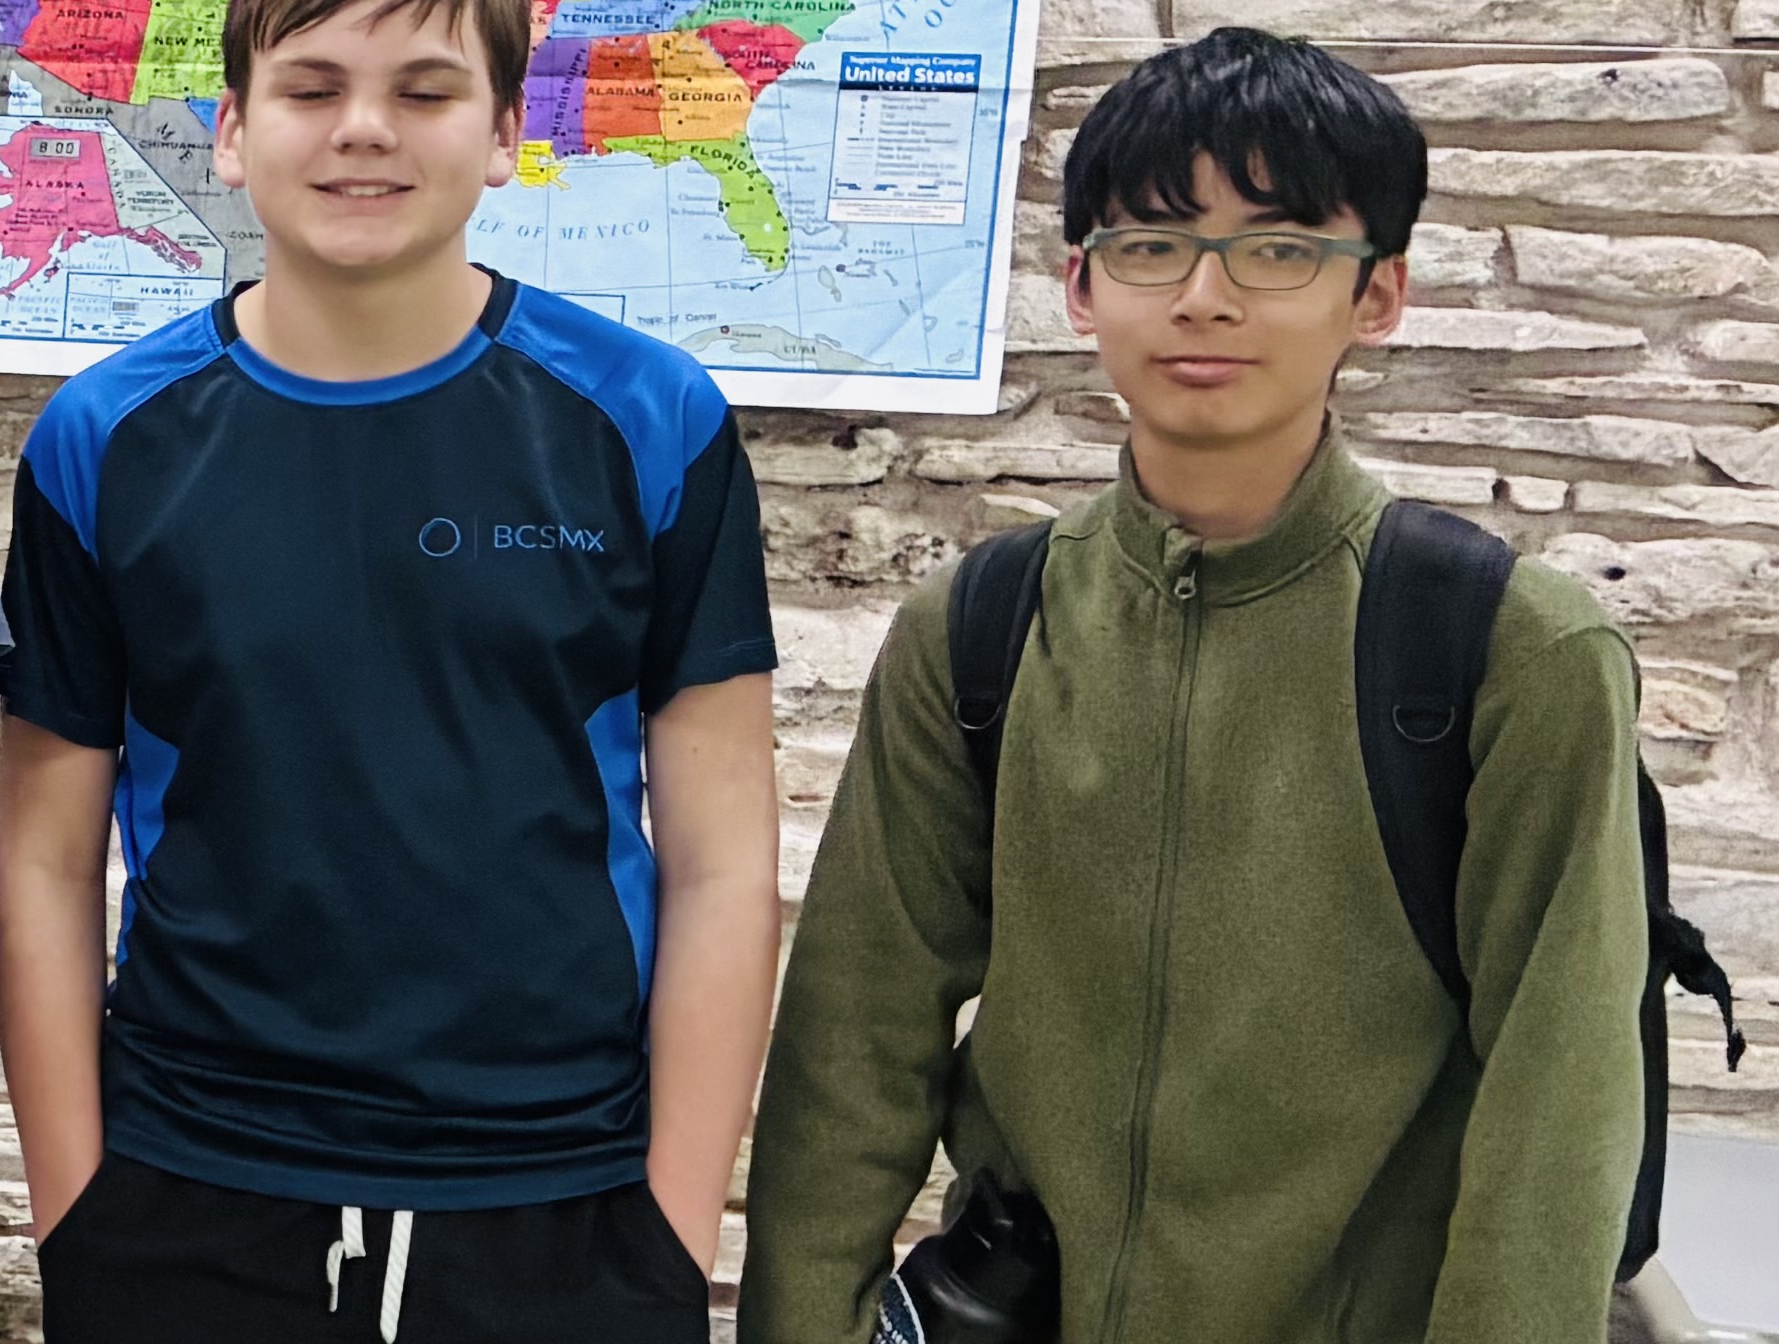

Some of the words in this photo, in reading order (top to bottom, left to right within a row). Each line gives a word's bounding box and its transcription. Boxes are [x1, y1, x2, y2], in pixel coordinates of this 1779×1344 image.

[708, 0, 767, 11] NORTH
[771, 0, 856, 12] CAROLINA
[55, 8, 124, 20] ARIZONA
[562, 13, 656, 25] TENNESSEE
[154, 36, 188, 47] NEW
[845, 66, 911, 83] United
[914, 67, 976, 84] States
[550, 47, 589, 138] MISSISSIPPI
[587, 86, 658, 98] ALABAMA
[668, 91, 743, 104] GEORGIA
[54, 105, 115, 115] SONORA
[690, 144, 756, 180] FLORIDA
[26, 180, 84, 190] ALASKA
[517, 224, 547, 237] OF
[559, 219, 651, 240] MEXICO
[140, 286, 194, 296] HAWAII
[493, 524, 605, 552] BCSMX
